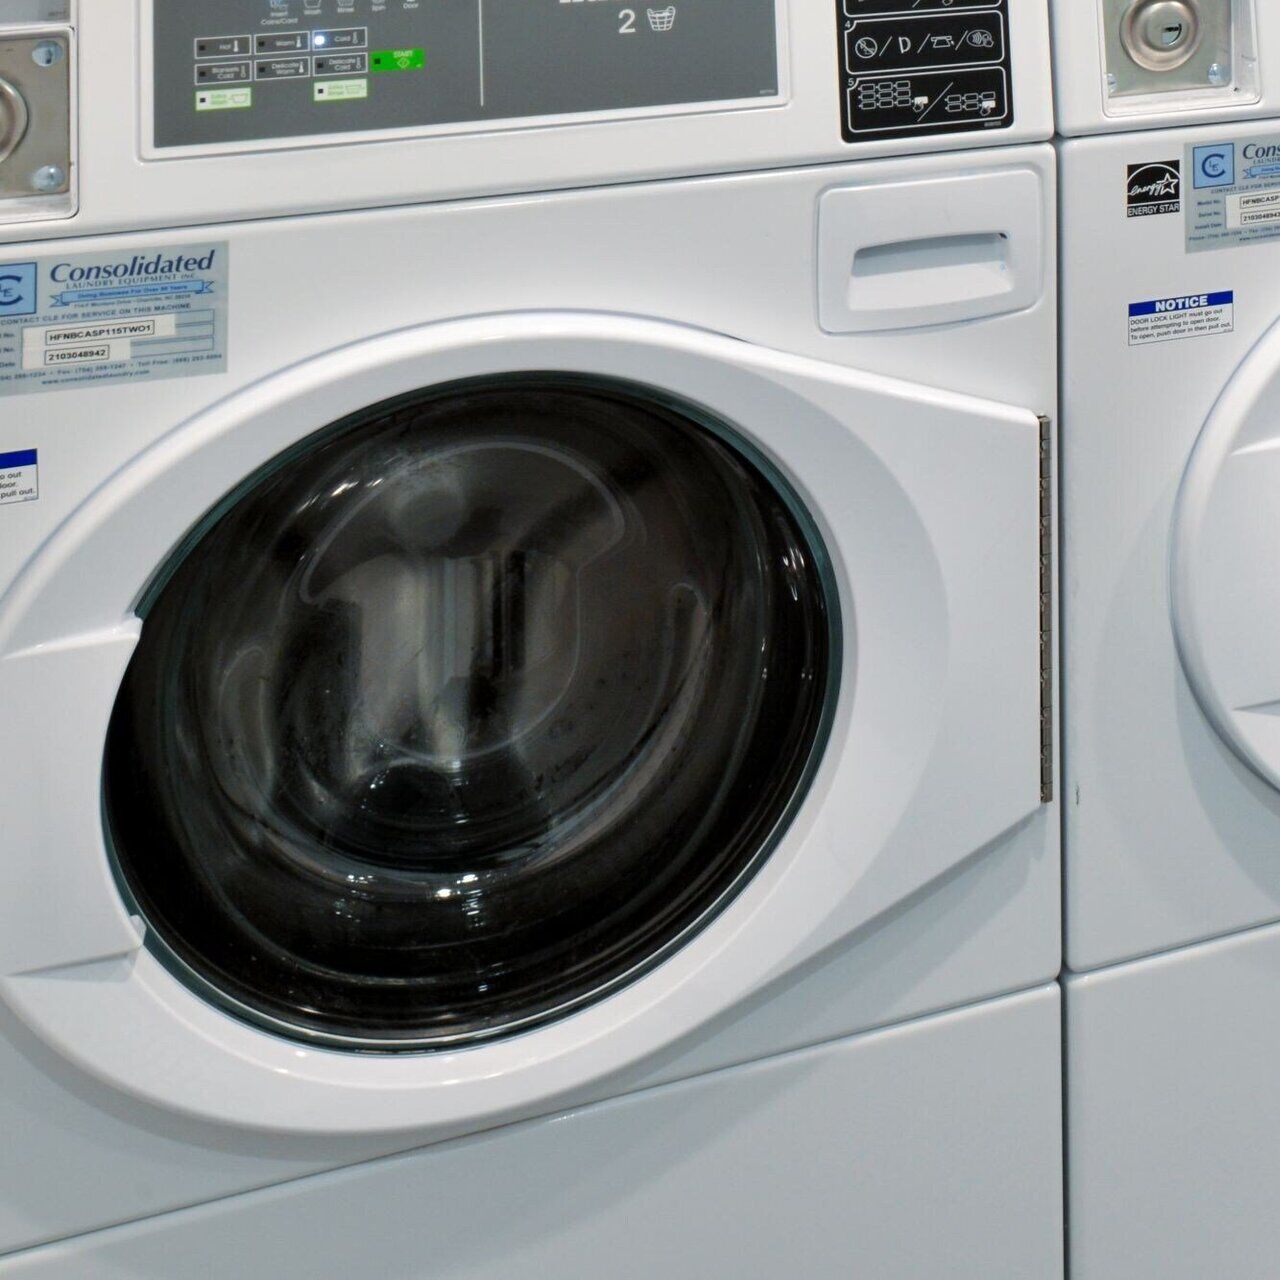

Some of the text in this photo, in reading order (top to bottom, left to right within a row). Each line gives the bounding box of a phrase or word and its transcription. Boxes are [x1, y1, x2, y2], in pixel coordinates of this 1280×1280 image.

[618, 9, 636, 33] 2
[844, 20, 851, 29] 4
[848, 78, 855, 87] 5
[1128, 203, 1180, 217] ENERGY STAR
[50, 249, 215, 283] Consolidated
[66, 279, 115, 290] LAUNDRY
[118, 274, 177, 285] EQUIPMENT
[1155, 296, 1208, 312] NOTICE
[1, 317, 39, 326] CONTACT
[81, 310, 116, 318] SERVICE
[154, 303, 191, 311] MACHINE
[1130, 318, 1149, 326] DOOR
[1150, 315, 1168, 323] LOCK
[1150, 321, 1182, 331] attempting
[1190, 317, 1205, 326] open
[48, 349, 106, 361] 2103048942
